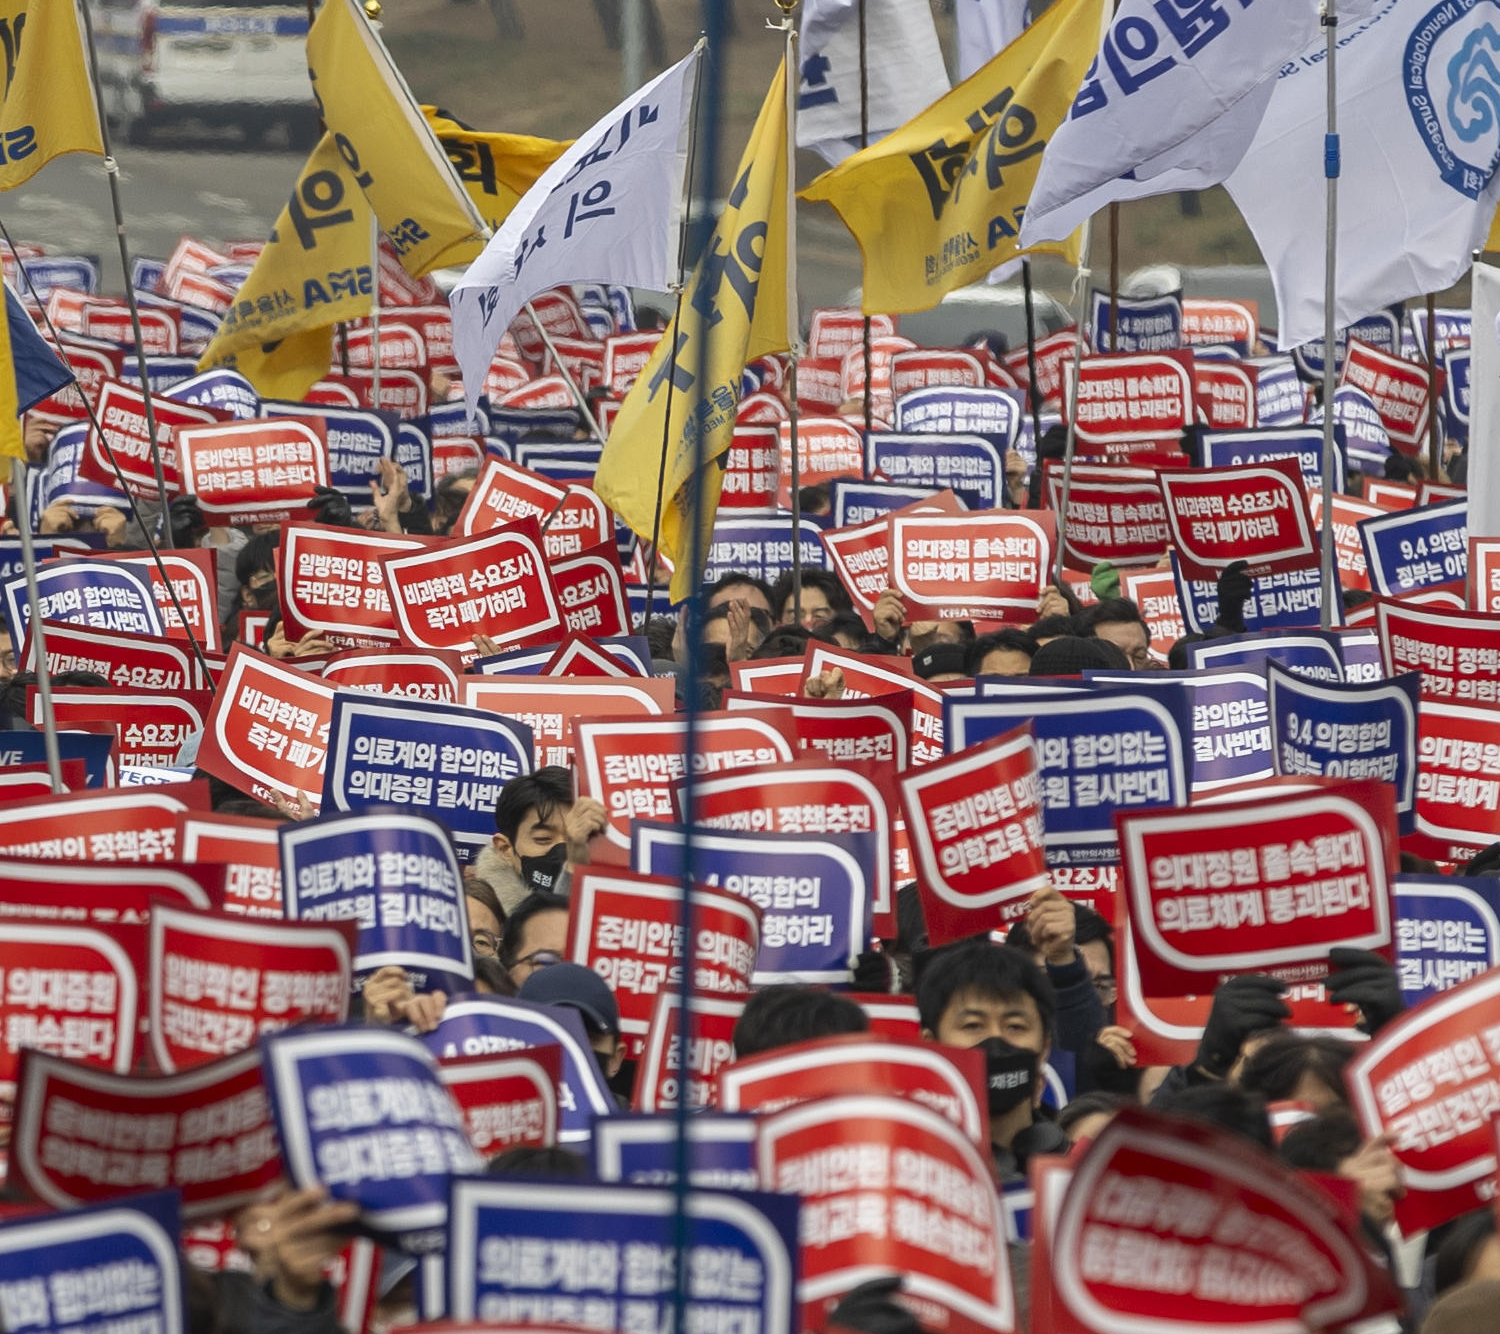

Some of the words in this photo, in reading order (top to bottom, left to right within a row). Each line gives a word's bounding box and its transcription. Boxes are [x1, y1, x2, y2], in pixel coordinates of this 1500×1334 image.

[194, 446, 252, 471] 준비안된
[253, 443, 313, 466] 의대증원
[197, 470, 255, 493] 의학교육
[258, 466, 316, 489] 훼손된다
[906, 538, 971, 560] 의대정원
[973, 536, 1037, 559] 졸속확대
[906, 562, 972, 583] 의료체계
[974, 560, 1038, 584] 붕괴된다
[1397, 558, 1444, 588] 정부는
[423, 601, 462, 631] 즉각
[462, 585, 528, 623] 폐기하라
[939, 608, 969, 619] KMA
[1392, 636, 1453, 672] 일방적인
[352, 735, 436, 772] 의료계와
[438, 745, 529, 782] 합의없는
[1071, 729, 1167, 764] 합의없는
[530, 869, 552, 890] 원점
[1152, 848, 1258, 892] 의대정원
[1259, 835, 1365, 879] 졸속확대
[377, 895, 462, 938] 결사반대
[1158, 891, 1265, 936] 의료체계
[1266, 876, 1371, 921] 붕괴된다
[162, 956, 261, 1000] 일방적인
[262, 957, 345, 1005] 정책추진
[1377, 1042, 1488, 1112] 일방적인
